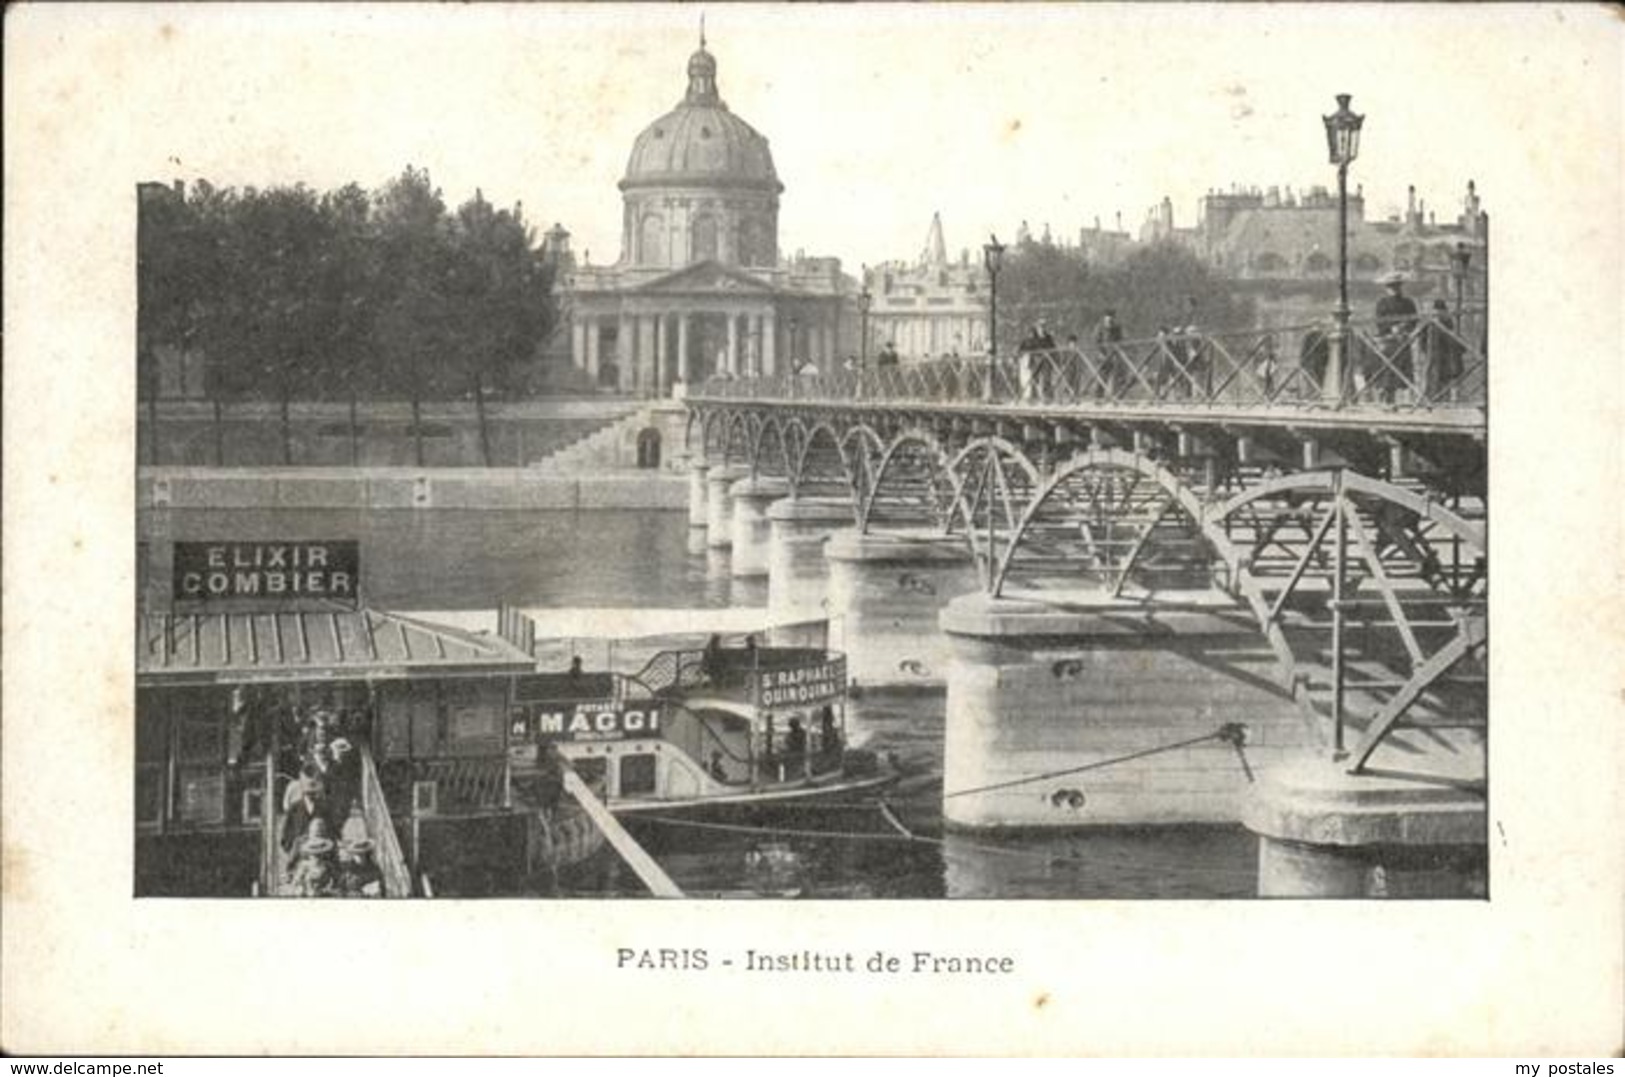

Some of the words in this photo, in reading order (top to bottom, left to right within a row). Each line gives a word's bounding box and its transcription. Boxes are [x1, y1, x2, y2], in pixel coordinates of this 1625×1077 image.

[208, 546, 328, 567] ELIXIR
[183, 572, 349, 593] COMBIER
[540, 711, 658, 732] MAGGI
[616, 949, 709, 970] PARIS
[745, 950, 855, 972] Institut
[866, 952, 900, 973] de
[912, 952, 1015, 973] France
